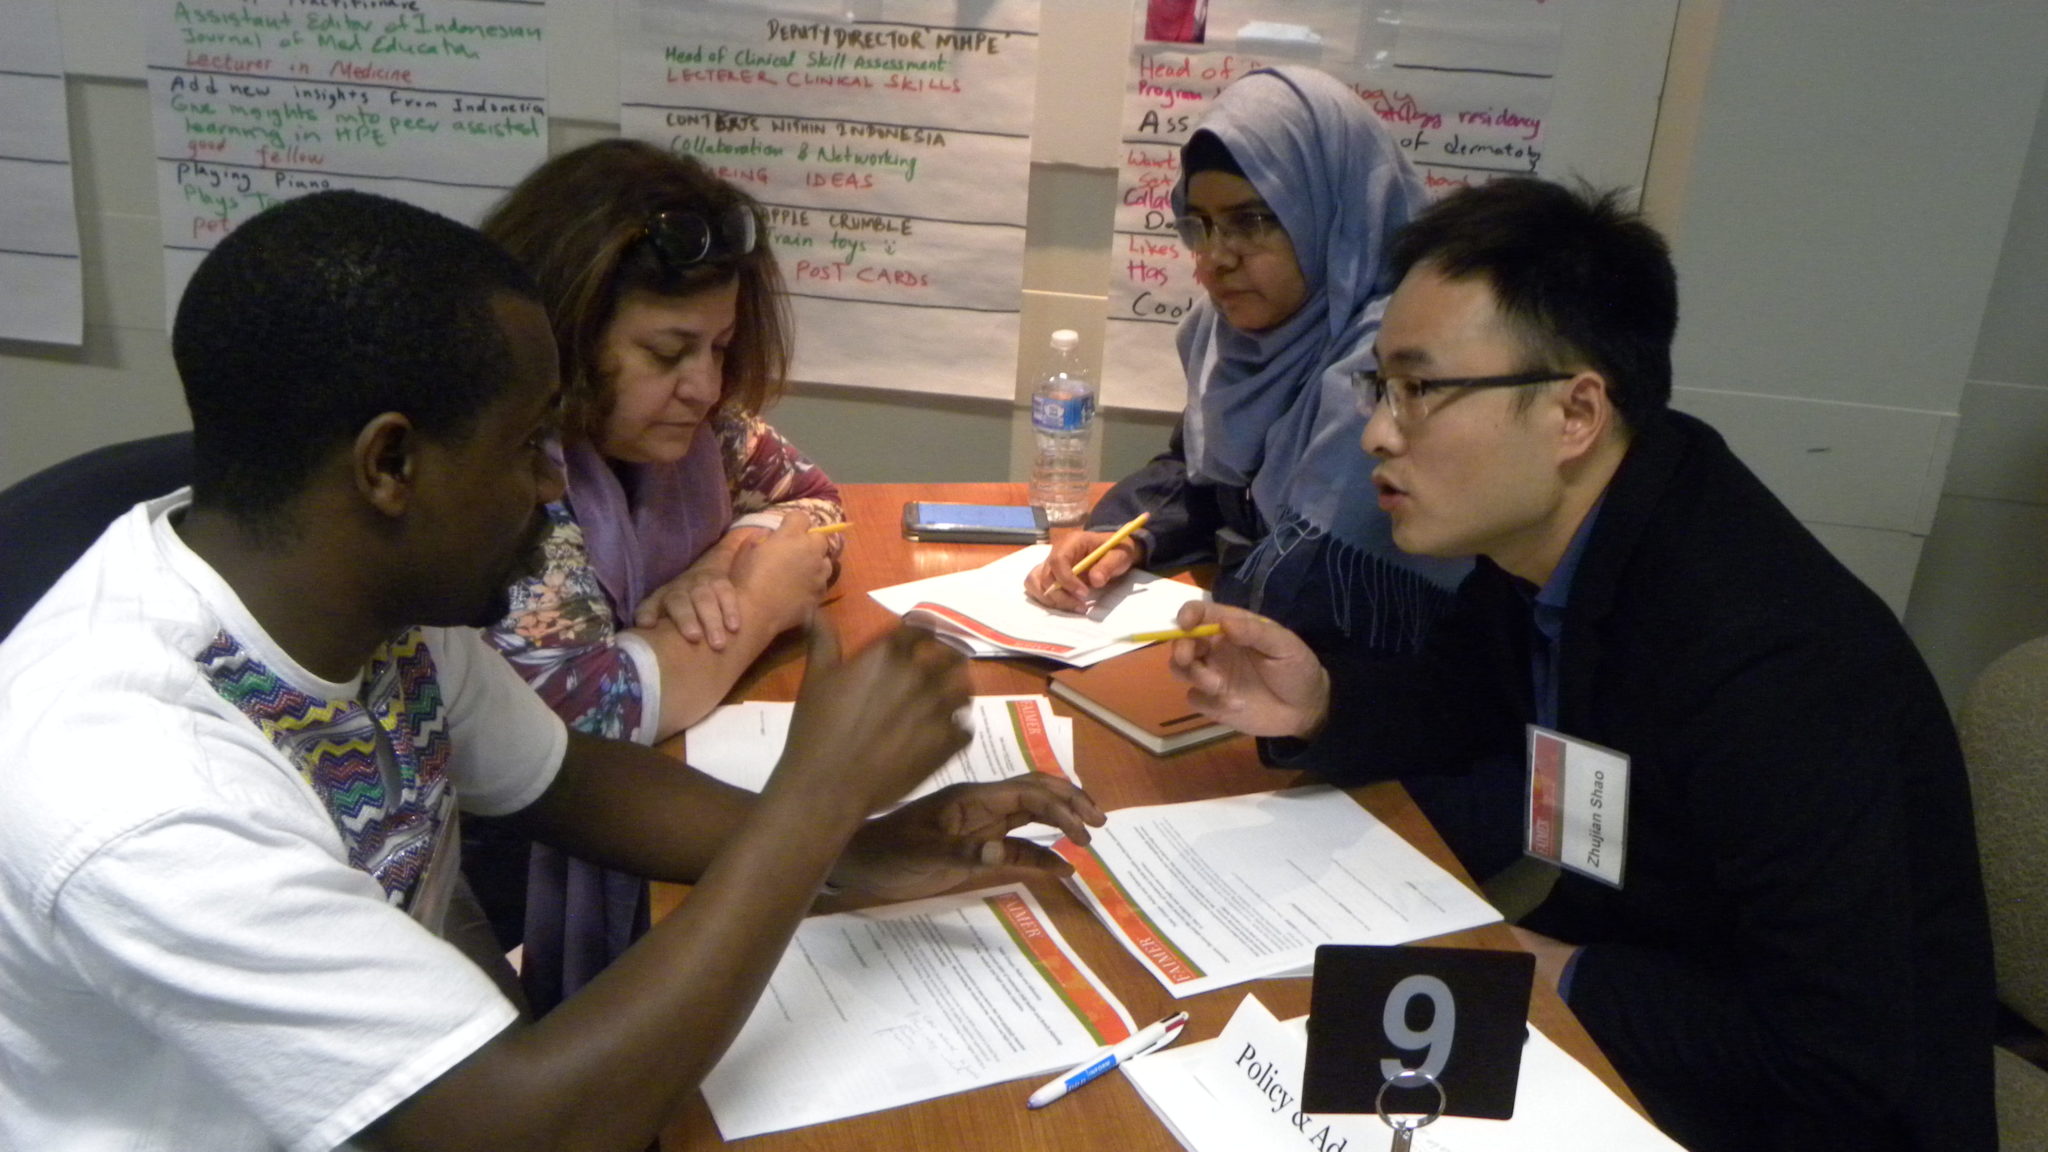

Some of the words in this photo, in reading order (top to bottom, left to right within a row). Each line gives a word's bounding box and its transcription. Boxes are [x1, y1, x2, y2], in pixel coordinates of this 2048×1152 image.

[175, 2, 290, 28] Assistant
[307, 13, 372, 33] Editor
[385, 14, 408, 33] of
[182, 28, 261, 48] Journal
[280, 31, 303, 47] of
[767, 18, 829, 45] DEPUTY
[833, 27, 925, 50] DIRECTOR
[186, 50, 272, 71] Lecturer
[291, 62, 309, 74] in
[330, 61, 412, 82] Medicine
[665, 45, 702, 63] Head
[709, 45, 728, 63] of
[735, 50, 796, 68] Clinical
[807, 51, 846, 69] Skill
[854, 54, 946, 71] Assessment
[1139, 54, 1190, 79] Head
[1201, 56, 1234, 79] of
[171, 75, 218, 95] Add
[230, 84, 271, 97] new
[295, 86, 368, 109] insights
[390, 91, 437, 107] from
[453, 99, 545, 116] Indonesia
[786, 72, 873, 88] CLINICAL
[885, 74, 961, 93] SKILLS
[1138, 80, 1203, 109] Program
[295, 124, 320, 142] in
[336, 123, 387, 147] HPE
[390, 116, 439, 135] peer
[453, 116, 540, 138] assisted
[771, 119, 825, 135] WITHIN
[836, 121, 946, 147] INDONESIA
[1458, 107, 1542, 140] residency
[187, 138, 228, 159] good
[257, 145, 325, 168] fellow
[1401, 131, 1429, 151] of
[671, 135, 783, 157] Collaboration
[818, 144, 917, 182] Networking
[275, 171, 330, 189] Piano
[806, 171, 873, 189] IDEAS
[829, 213, 913, 236] CRUMBLE
[831, 231, 866, 264] toys
[1129, 236, 1180, 260] Likes
[796, 260, 847, 282] POST
[857, 267, 928, 287] CARDS
[1127, 259, 1168, 286] Has
[1591, 770, 1605, 809] Shao
[1587, 813, 1604, 868] Zhujian
[1139, 936, 1193, 981] FAIMER
[1380, 974, 1456, 1088] 9
[1234, 1042, 1294, 1113] Policy
[1291, 1111, 1313, 1133] &
